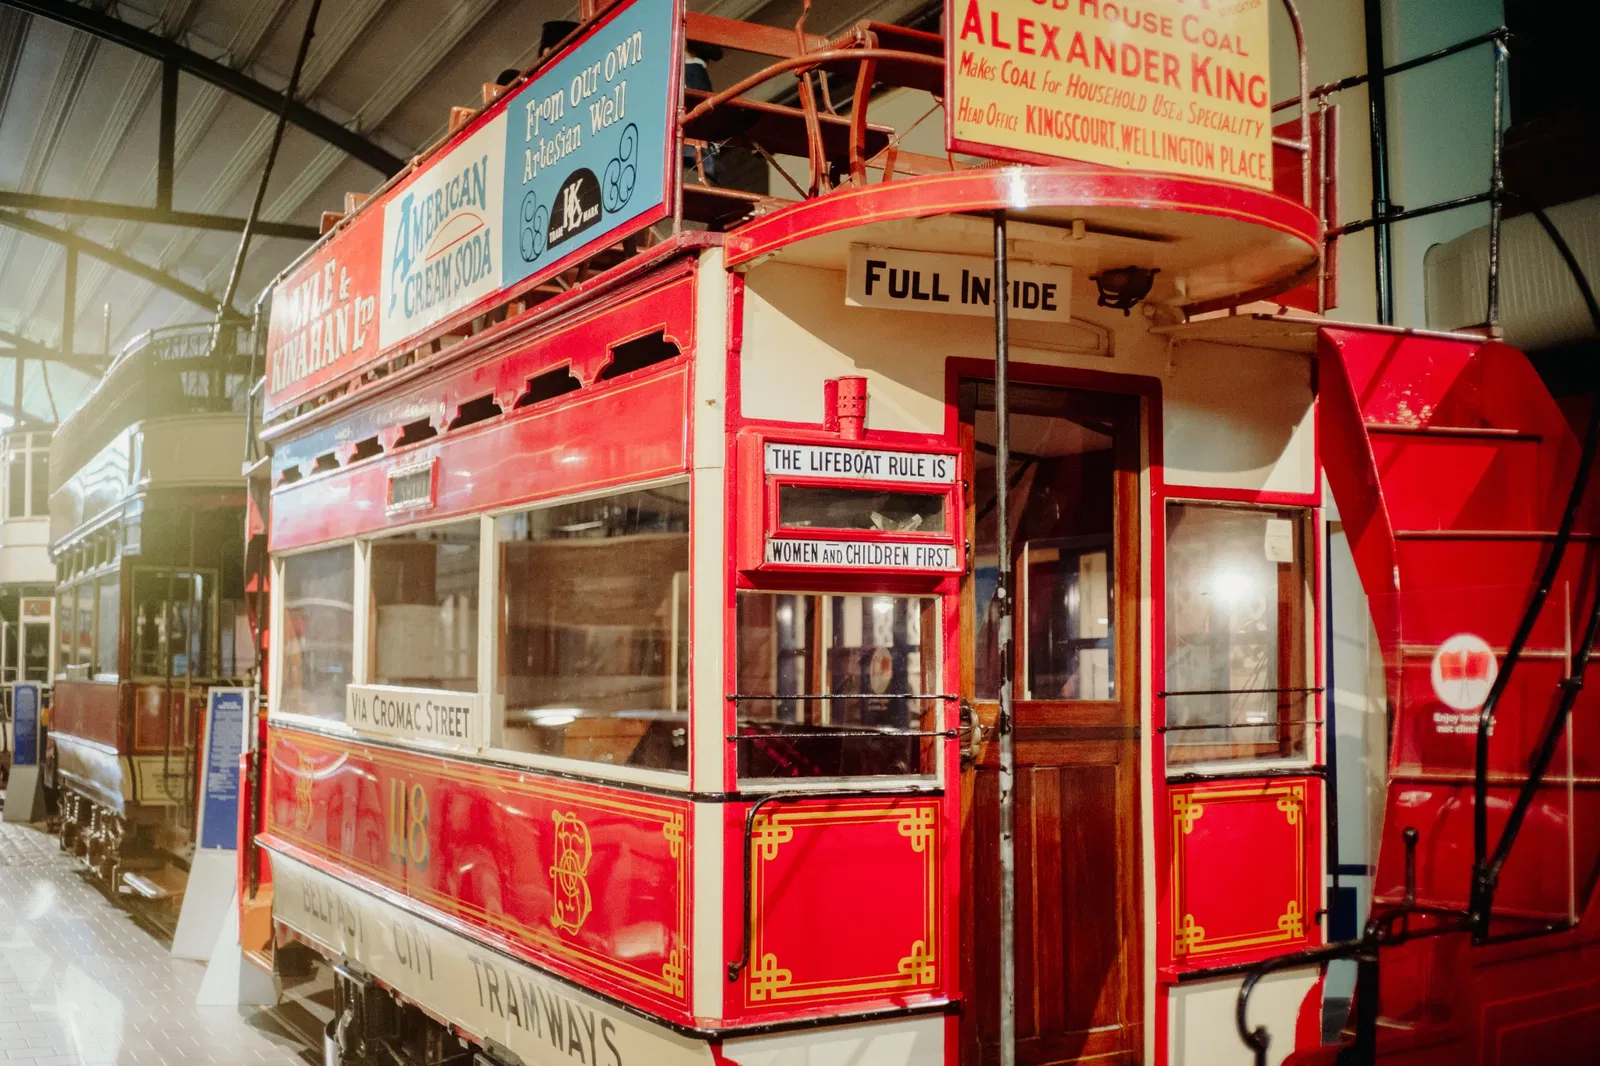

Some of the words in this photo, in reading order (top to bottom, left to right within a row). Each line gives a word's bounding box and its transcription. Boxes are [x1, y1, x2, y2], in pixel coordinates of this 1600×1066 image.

[959, 0, 1182, 90] ALEXANDER
[1191, 52, 1269, 109] KING
[1079, 0, 1173, 37] HOUSE
[1181, 13, 1249, 57] COAL
[525, 88, 565, 142] From
[1001, 59, 1036, 90] COAL
[1065, 73, 1148, 113] HOUSEHOLD
[1152, 93, 1177, 120] USE
[1187, 101, 1265, 140] SPECIALITY
[522, 122, 582, 185] Artesian
[589, 80, 627, 137] Well
[957, 96, 984, 124] HEAD
[986, 101, 1019, 131] OFFICE
[1121, 124, 1215, 170] WELLINGTON
[388, 154, 488, 319] AMERICAN
[583, 204, 599, 222] MARK
[339, 265, 351, 302] &
[404, 252, 453, 319] CREAM
[454, 227, 492, 296] SODA
[865, 259, 949, 302] FULL
[270, 303, 350, 396] KINAHAN
[772, 449, 802, 470] THE
[810, 452, 881, 475] LIFEBOAT
[889, 456, 925, 477] RULE
[933, 459, 946, 478] IS
[772, 542, 818, 563] WOMEN
[823, 549, 843, 564] AND
[846, 544, 909, 566] CHILDREN
[916, 547, 950, 568] FIRST
[373, 695, 421, 731] CROMAC
[426, 700, 470, 738] STREET
[1433, 713, 1459, 724] Enjoy
[1436, 725, 1454, 733] not
[390, 777, 429, 868] 118
[393, 919, 433, 981] CITY
[468, 953, 622, 1066] TRAMWAYS
